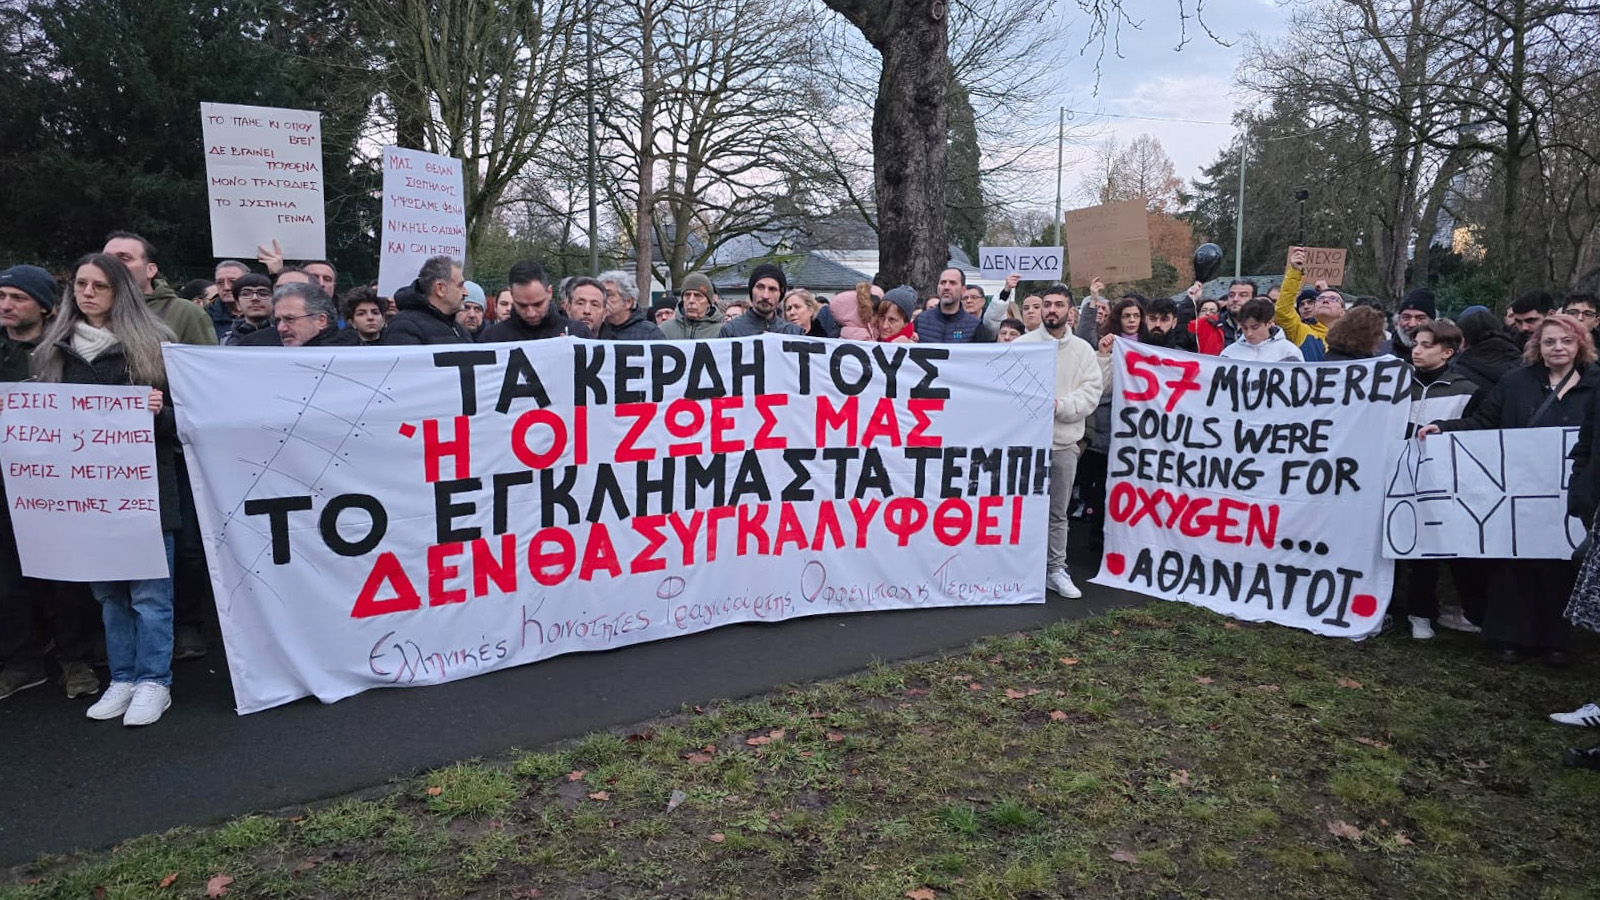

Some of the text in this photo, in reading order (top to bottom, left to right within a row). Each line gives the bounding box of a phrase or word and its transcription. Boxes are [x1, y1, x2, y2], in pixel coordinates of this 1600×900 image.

[284, 122, 312, 132] ΟΠΟΥ
[209, 146, 274, 158] ΔΕ ΒΓΑΙΝΕΙ
[266, 161, 319, 172] ΠΟΥΘΕΝΑ
[390, 155, 412, 170] ΜΑΣ
[251, 178, 319, 191] ΤΡΑΓΩΔΙΕΣ
[405, 176, 456, 196] ΣΙΩΠΗΛΟΥΣ
[215, 199, 231, 207] ΤΟ
[277, 214, 314, 224] ΓΕΝΝΑ
[388, 220, 428, 233] ΝΙΚΗΣΕ
[388, 241, 405, 253] ΚΑΙ
[433, 340, 950, 416] ΤΑ ΚΕΡΔΗ ΤΟΥΣ
[1121, 350, 1415, 412] 57 MURDERED
[7, 393, 145, 411] ΕΣΕΙΣ ΜΕΤΡΑΤΕ
[2, 425, 61, 444] ΚΕΡΔΗ
[91, 429, 153, 446] ΖΗΜΙΕΣ
[511, 405, 588, 469] ΟΙ
[614, 394, 788, 463] ΖΩΕΣ
[815, 396, 945, 448] ΜΑΣ
[1114, 407, 1333, 454] SOULS WERE
[10, 463, 152, 480] ΕΜΕΙΣ ΜΕΤΡΑΜΕ
[1110, 446, 1361, 496] SEEKING FOR
[14, 496, 157, 513] ΑΝΘΡΩΠΙΝΕΣ ΖΩΕΣ
[244, 446, 1051, 565] ΤΟ ΕΓΚΛΗΜΑ ΣΤΑ ΤΕΜΠΗ
[350, 533, 517, 619] ΔΕΝ
[1128, 548, 1363, 628] ΑΘΑΝΑΤΟΙ
[369, 631, 507, 684] Ελληνικές
[521, 597, 650, 648] Κοινότητες
